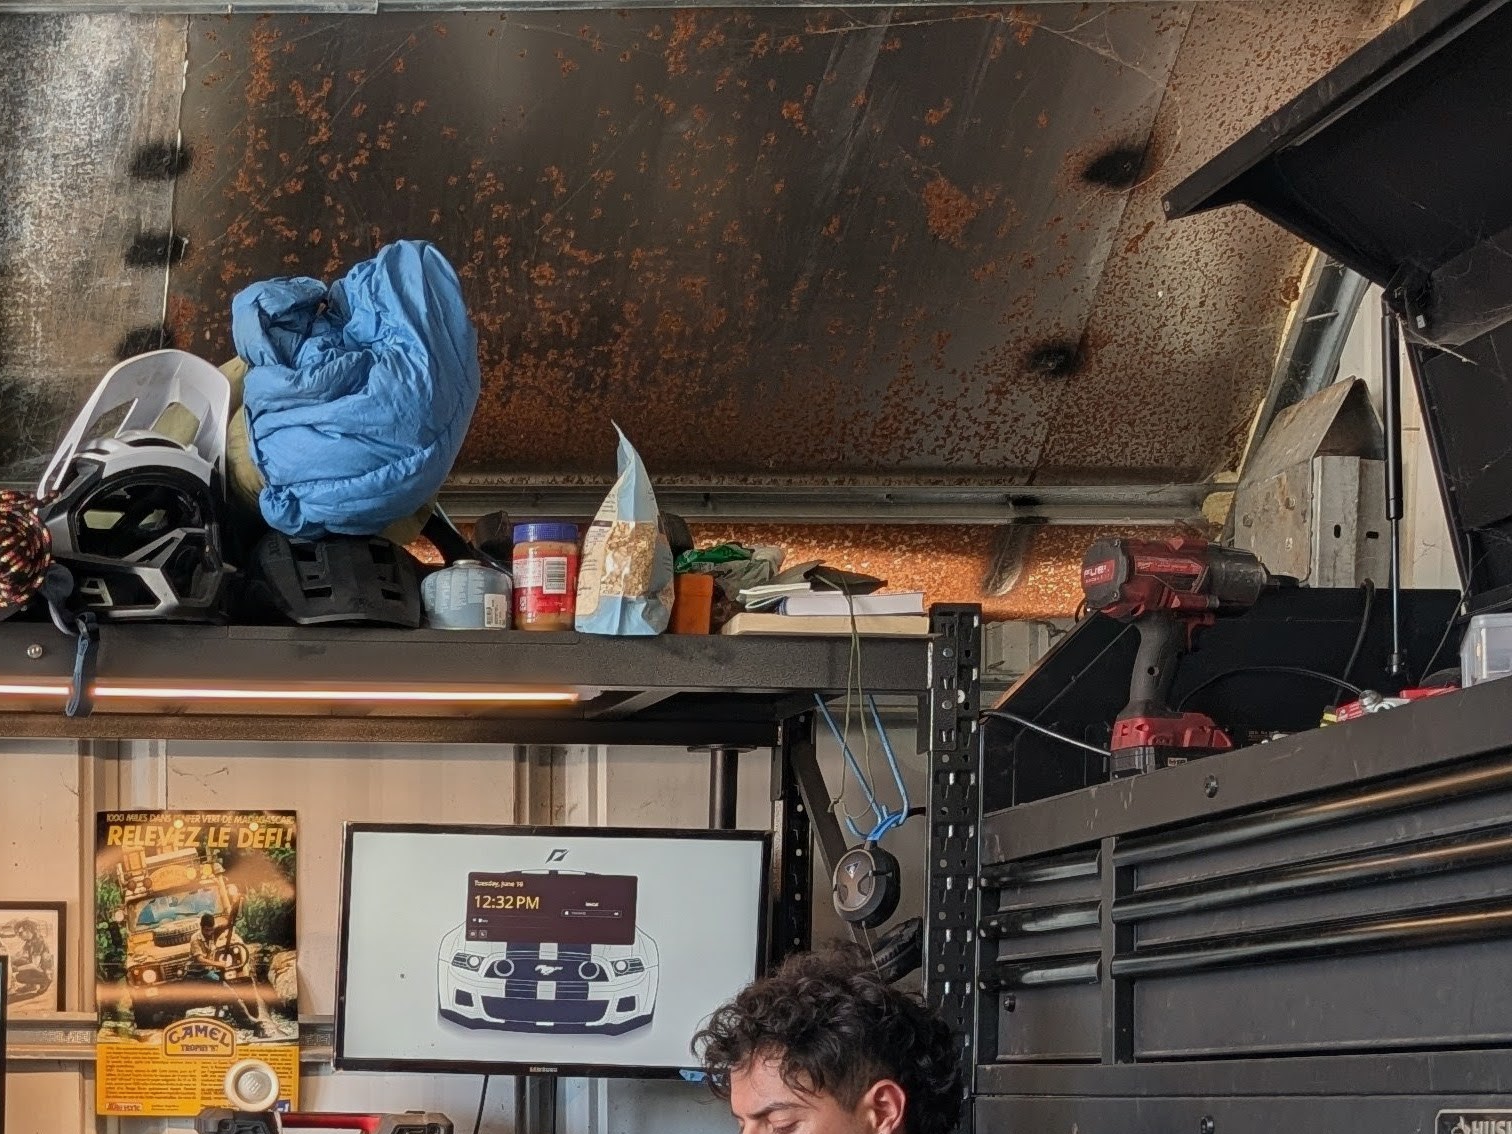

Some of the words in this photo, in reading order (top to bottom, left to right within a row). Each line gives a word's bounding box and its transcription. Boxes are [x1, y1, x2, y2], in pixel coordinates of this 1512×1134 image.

[106, 813, 124, 822] 1000
[126, 814, 148, 822] MILES
[149, 814, 172, 823] DANS
[202, 815, 221, 823] VERT
[222, 815, 233, 823] DE
[107, 825, 202, 847] RELEVEZ
[208, 827, 231, 848] LE
[474, 895, 513, 909] 12:32
[516, 896, 540, 910] PM
[169, 1025, 230, 1047] CAMEL
